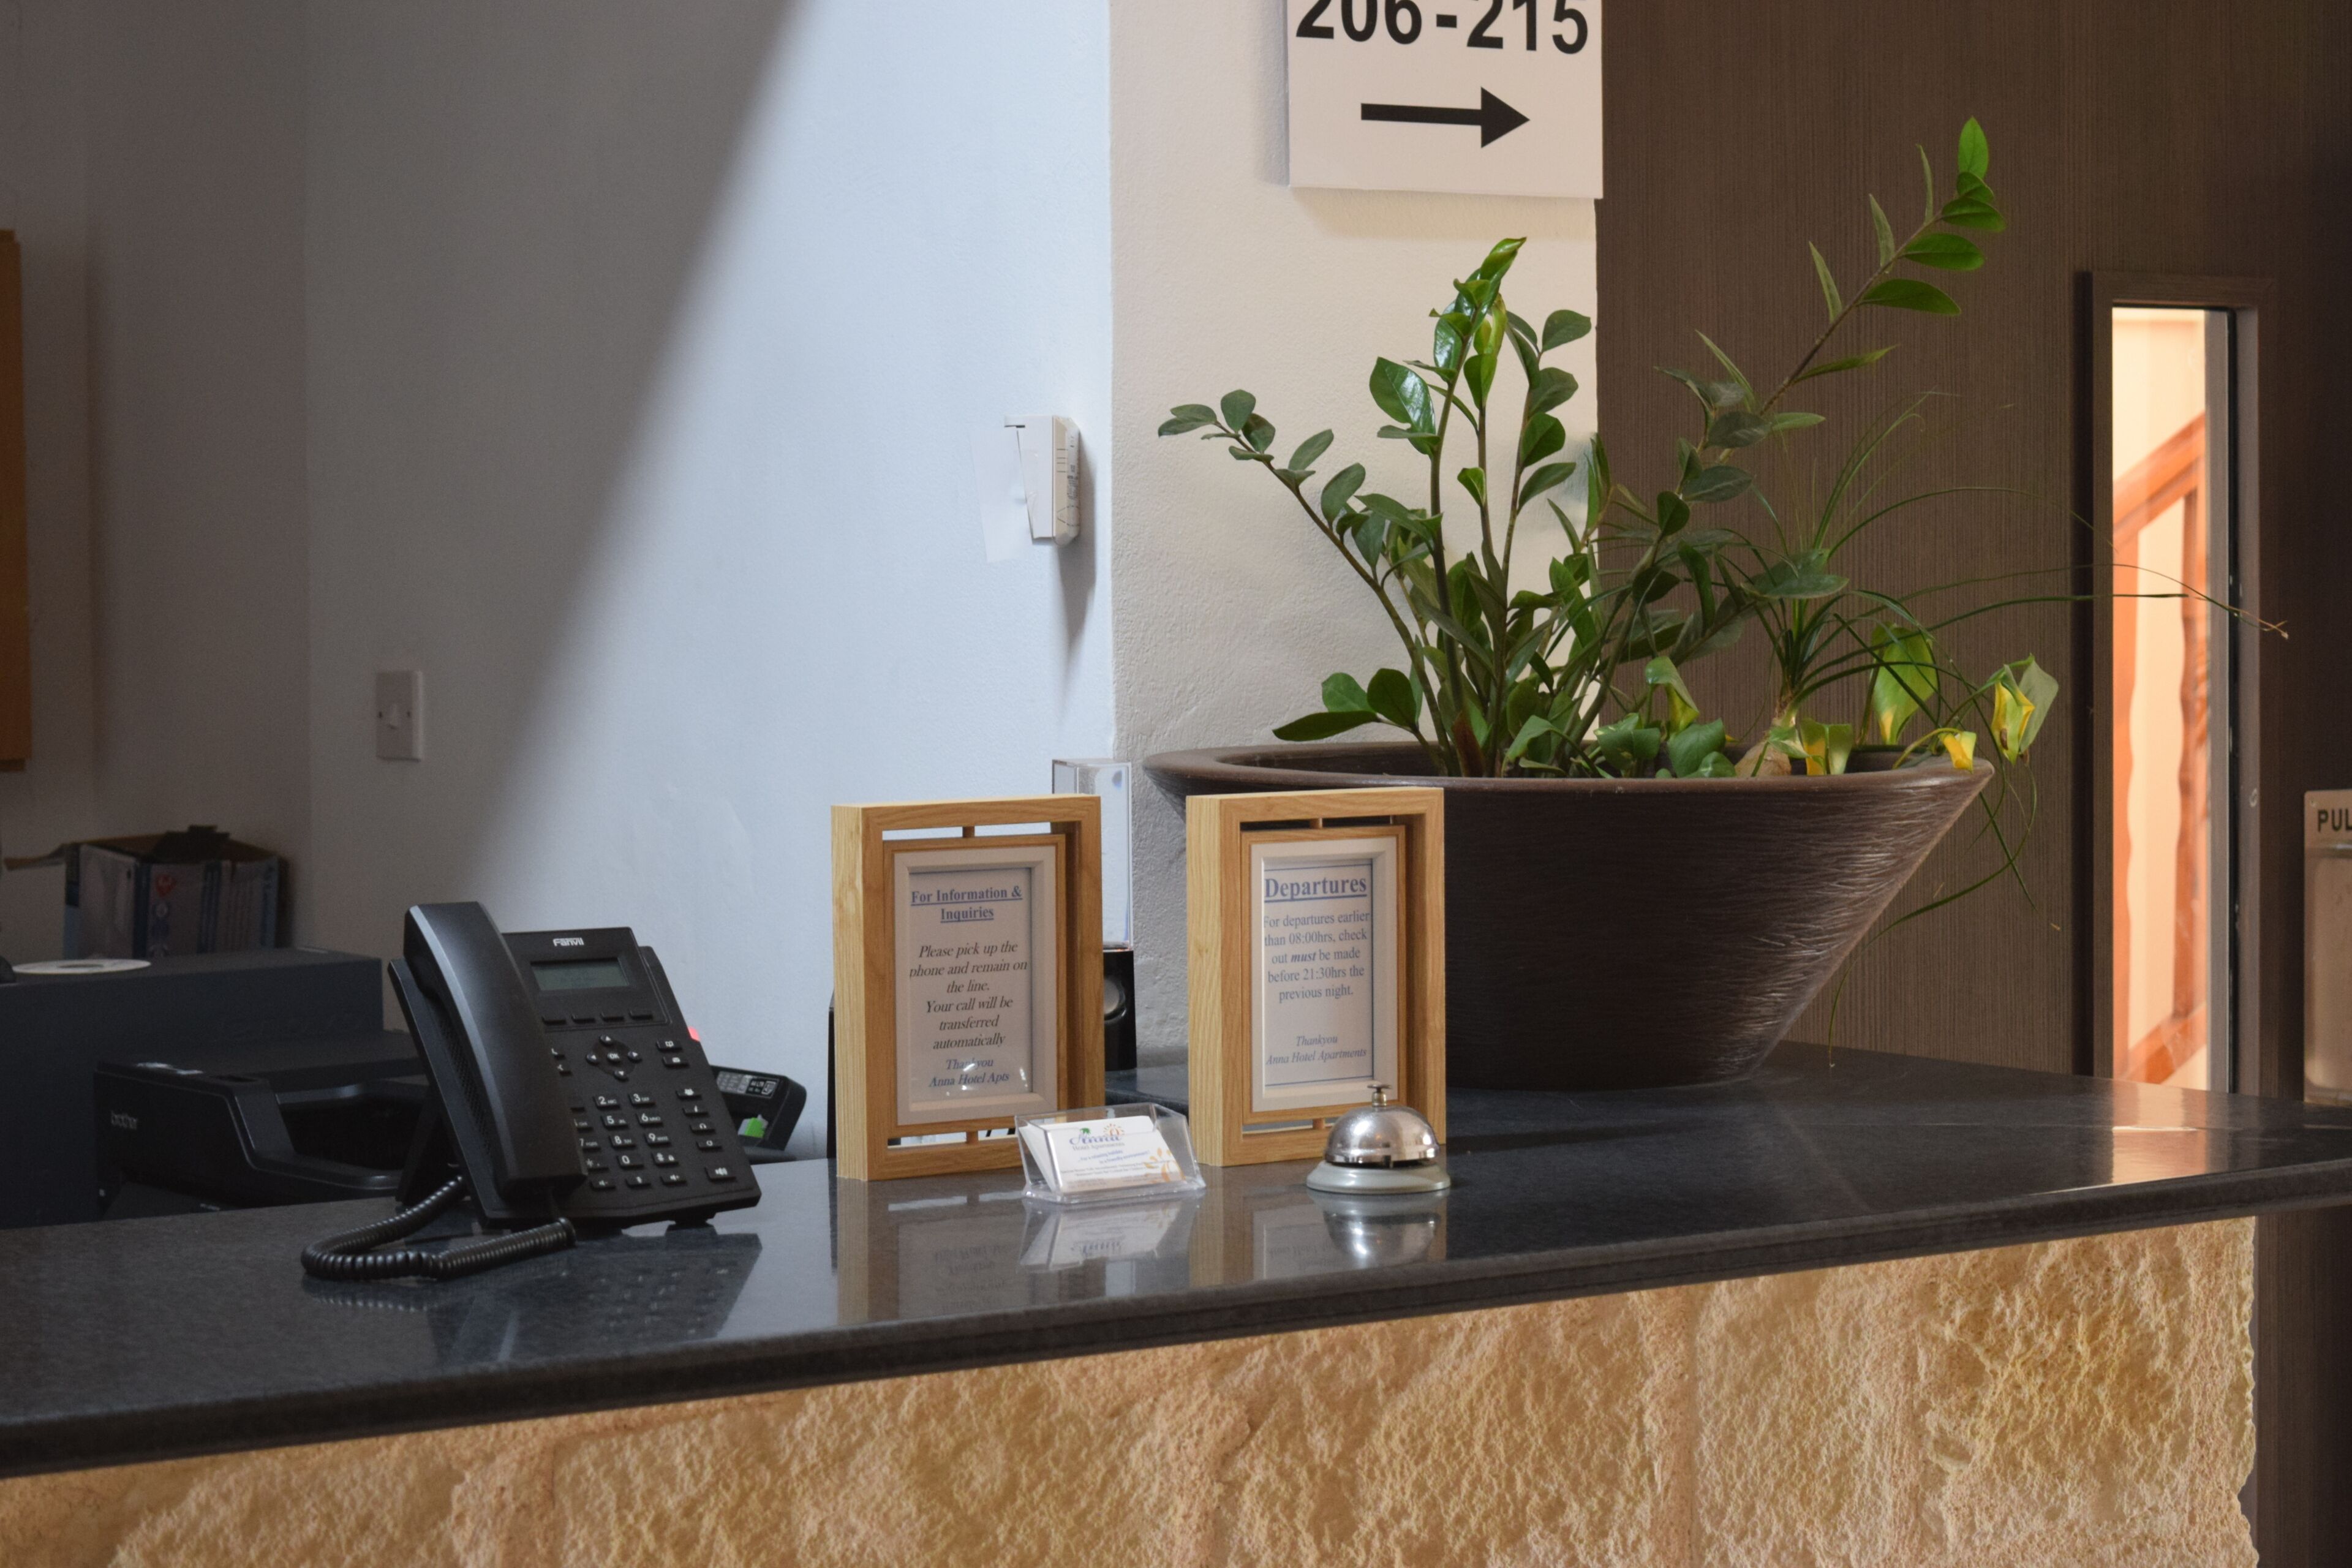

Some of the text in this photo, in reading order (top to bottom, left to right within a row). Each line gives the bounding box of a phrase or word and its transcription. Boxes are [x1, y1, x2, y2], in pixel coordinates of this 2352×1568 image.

[911, 885, 1022, 904] For Information &
[1264, 877, 1367, 901] Departures
[940, 907, 994, 922] Inquiries
[1264, 910, 1370, 929] For departures earlier
[552, 937, 584, 946] Fanvil
[1264, 928, 1367, 946] than 08:00hrs, check
[919, 941, 1018, 959] Please pick up the
[1272, 948, 1360, 964] out must be made
[910, 959, 1027, 979] phone and remain on
[1268, 965, 1365, 983] before 21:30hrs the
[946, 979, 990, 993] the line.
[1279, 985, 1354, 1003] previous night.
[925, 997, 1013, 1013] Your call will be
[939, 1016, 999, 1031] transferred
[932, 1032, 1006, 1050] automatically
[1296, 1035, 1338, 1047] Thankyou
[1265, 1048, 1366, 1065] Anna Hotel Apartments
[929, 1072, 1009, 1088] Anna Hotel Apts
[633, 1093, 641, 1102] 3
[614, 1136, 622, 1144] 8
[649, 1133, 656, 1142] 9
[622, 1155, 630, 1164] 0
